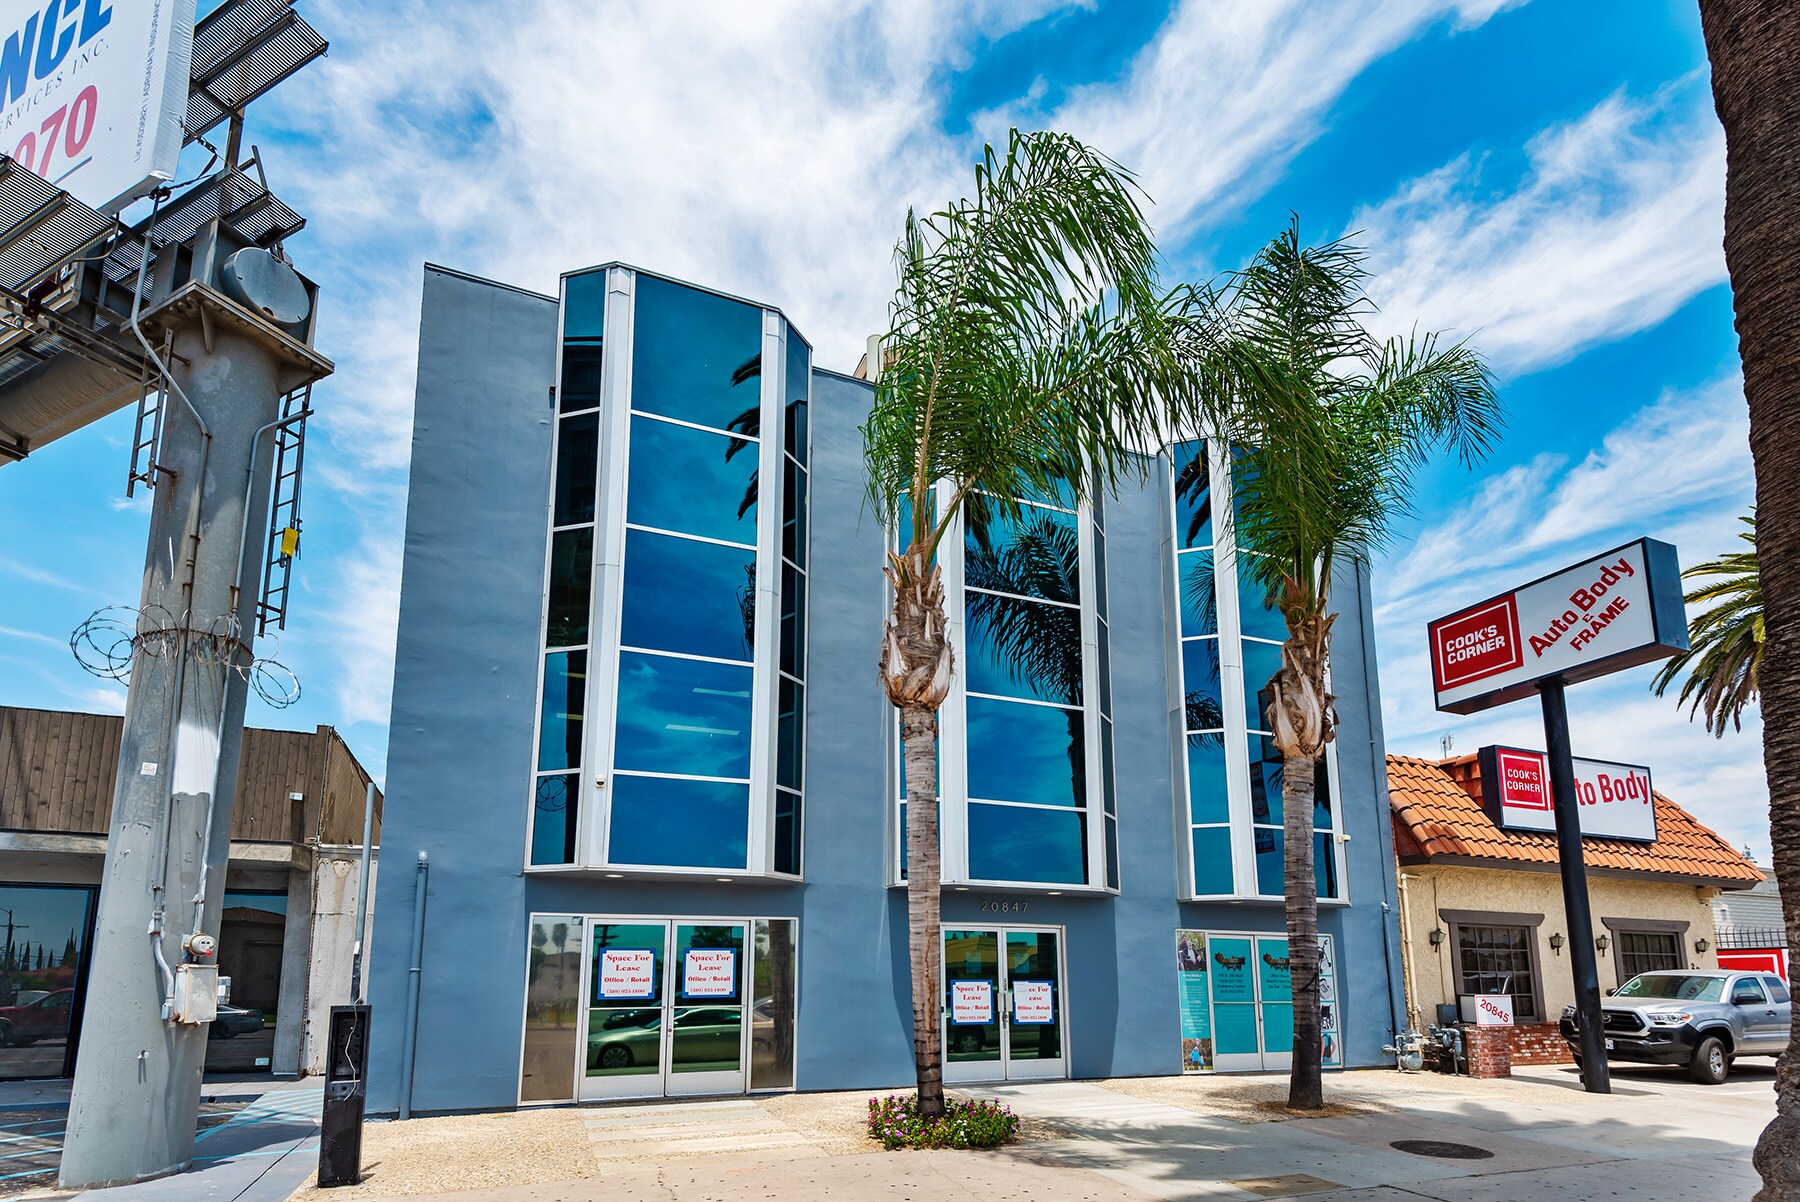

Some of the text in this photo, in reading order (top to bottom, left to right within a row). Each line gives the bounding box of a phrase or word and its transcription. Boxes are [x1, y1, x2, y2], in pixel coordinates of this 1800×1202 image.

[72, 38, 110, 76] INC.
[1528, 557, 1635, 658] Auto Body
[1569, 596, 1630, 652] FRAME
[1582, 613, 1595, 623] &
[1446, 624, 1498, 652] COOK'S
[1447, 635, 1506, 665] CORNER
[1507, 768, 1538, 781] COOK'S
[1506, 781, 1541, 793] CORNER
[1574, 770, 1649, 806] to Body
[981, 900, 1029, 912] 20847
[606, 954, 632, 963] Space
[690, 954, 714, 963] Space
[955, 985, 975, 993] Space
[1480, 998, 1510, 1023] 20845
